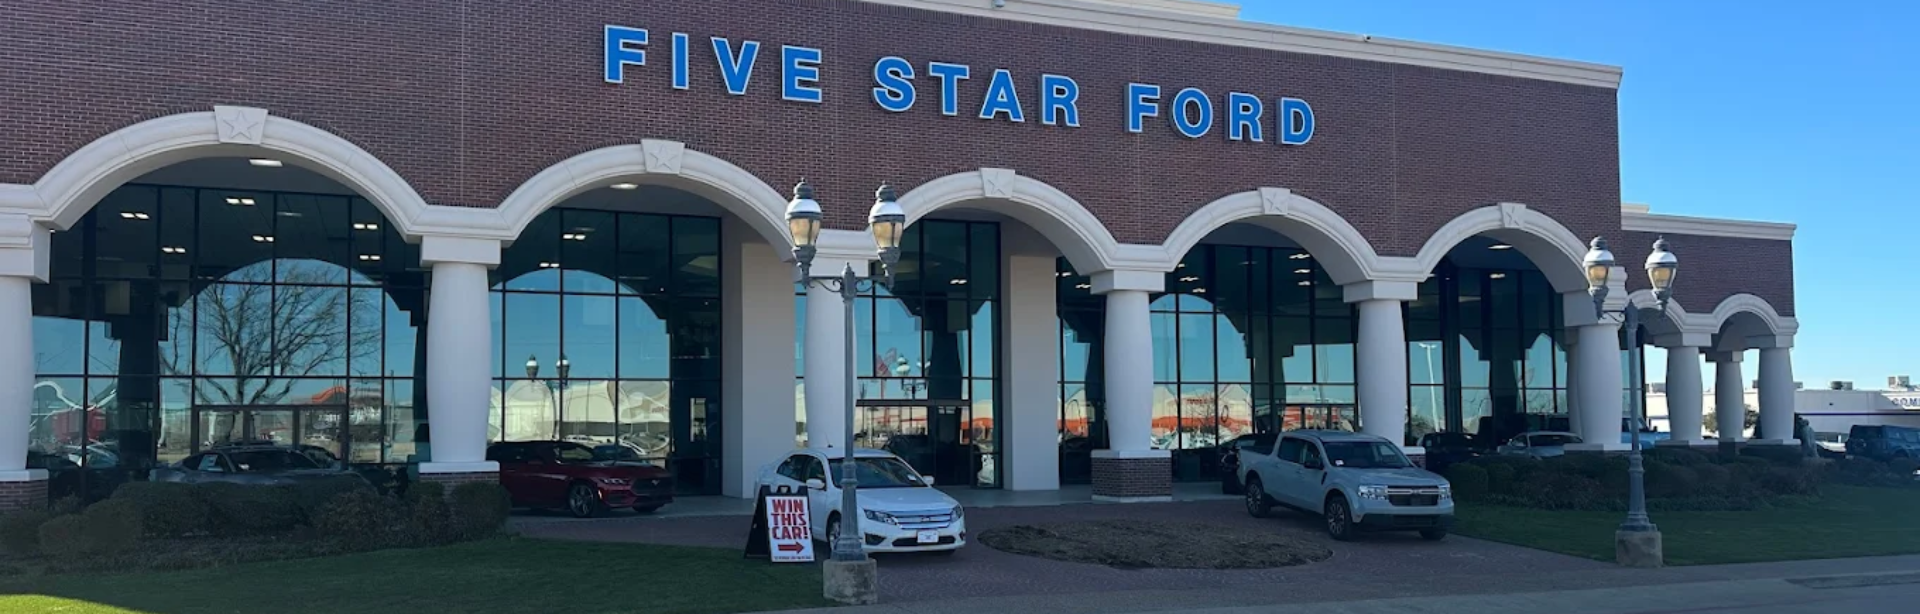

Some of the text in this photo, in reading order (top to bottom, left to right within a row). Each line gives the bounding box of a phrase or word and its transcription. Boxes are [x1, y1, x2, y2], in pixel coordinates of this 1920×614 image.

[604, 24, 1315, 145] FIVE STAR FORD
[1891, 397, 1920, 407] COM
[772, 499, 804, 512] WIN
[771, 513, 807, 526] THIS
[772, 526, 809, 539] CAR!
